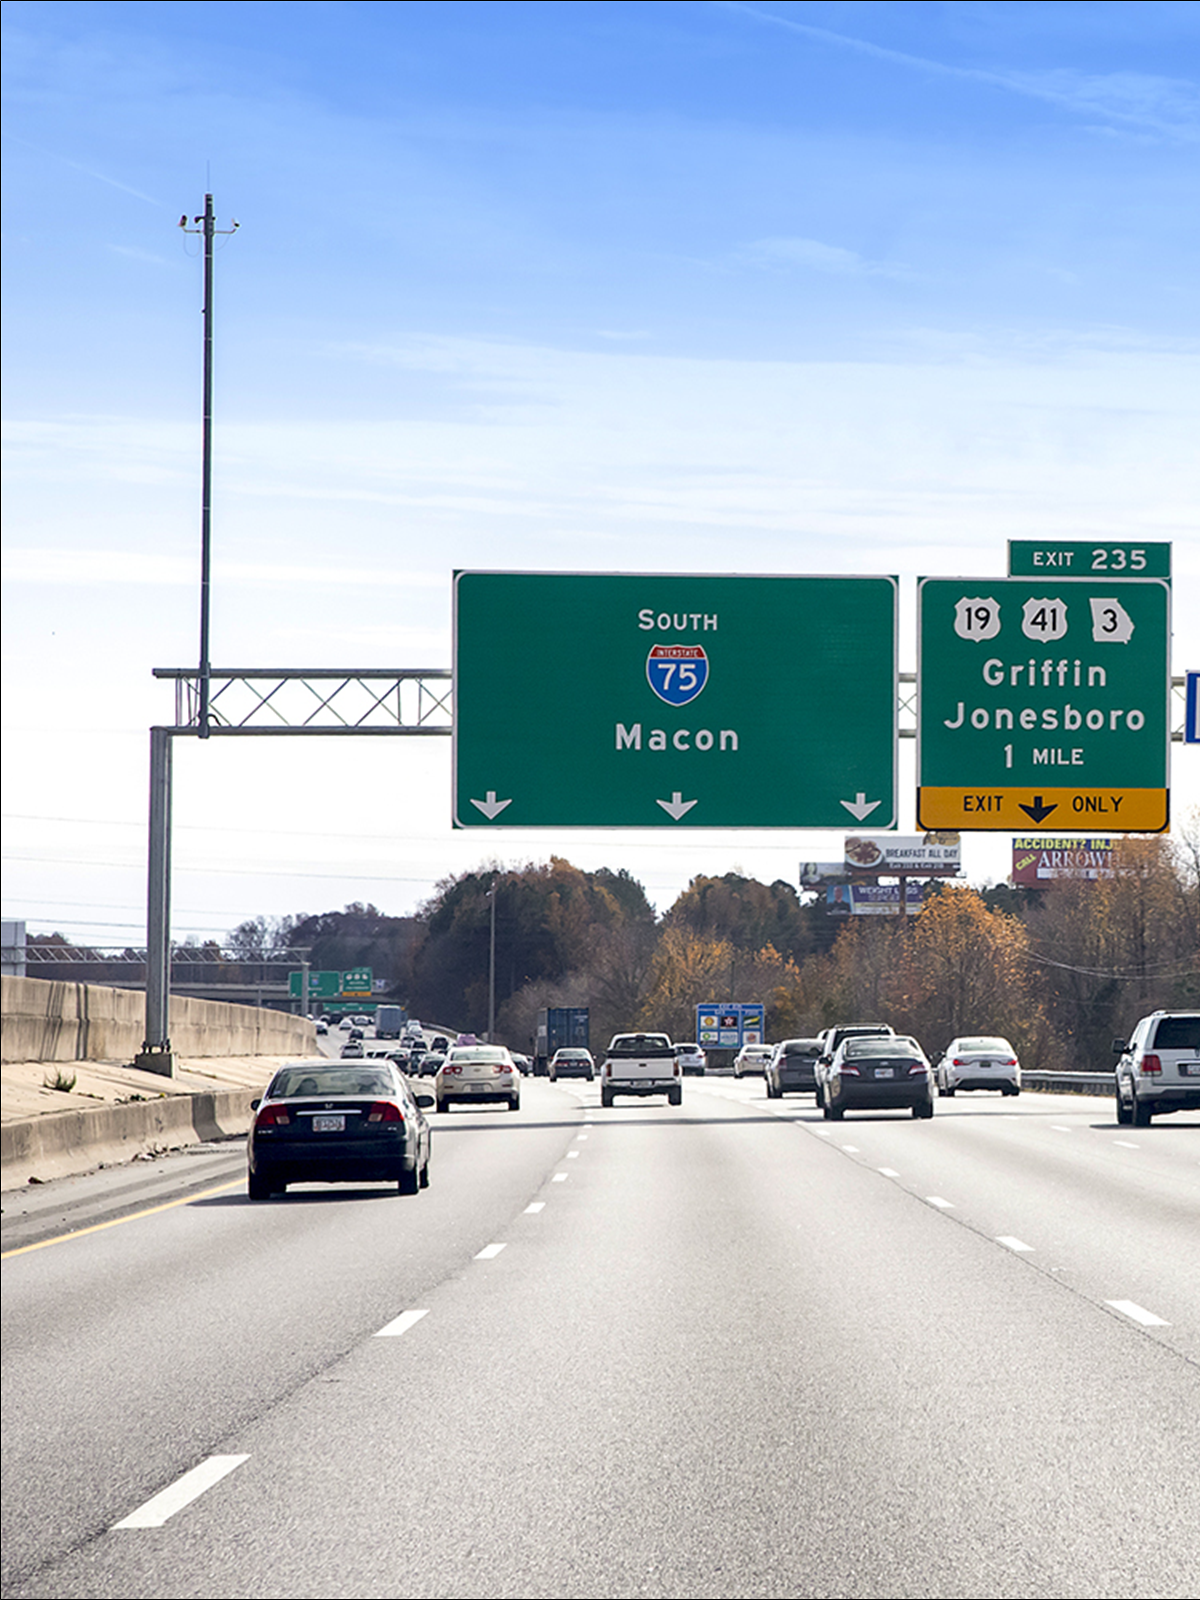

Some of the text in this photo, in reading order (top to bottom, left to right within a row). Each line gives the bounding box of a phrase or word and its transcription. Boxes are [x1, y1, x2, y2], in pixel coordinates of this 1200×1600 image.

[1033, 549, 1148, 571] EXIT 235
[638, 608, 718, 631] SOUTH
[965, 607, 991, 631] 19
[1030, 607, 1058, 632] 41
[1101, 609, 1119, 633] 3
[656, 648, 699, 658] INTERSTATE
[657, 663, 698, 691] 75
[982, 658, 1107, 687] Griffin
[944, 701, 1146, 731] Jonesboro
[615, 722, 739, 751] Macon
[1004, 744, 1085, 768] 1 MILE
[963, 795, 1124, 813] EXIT ONLY
[885, 848, 959, 859] BREAKFAST ALL DAY
[1014, 838, 1087, 850] ACCIDENT?
